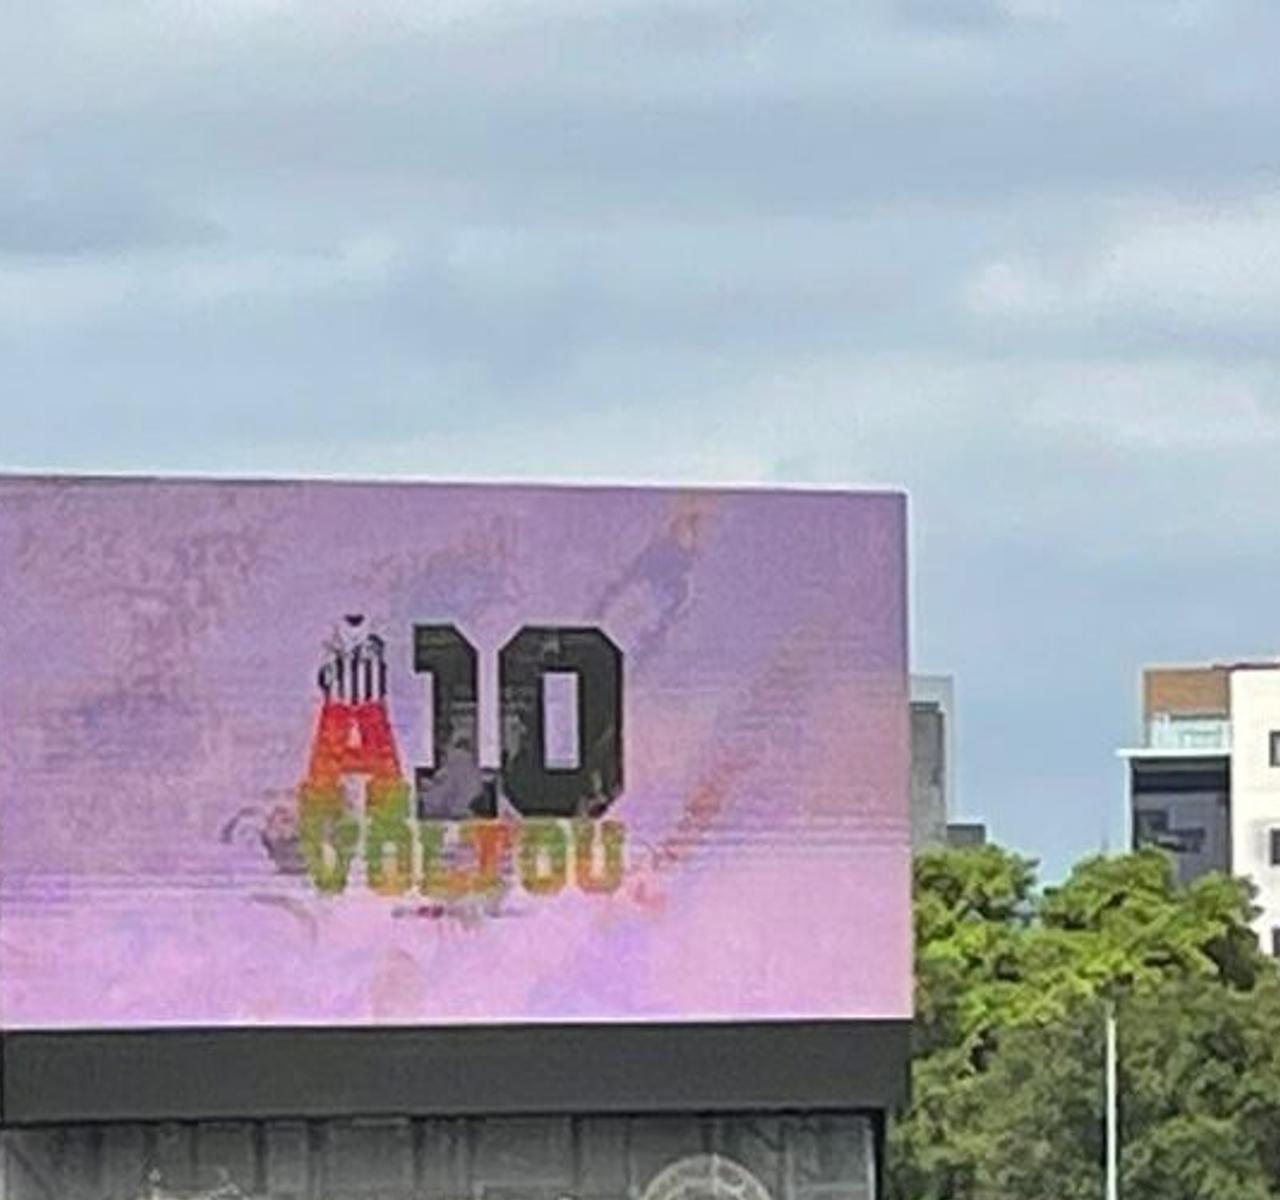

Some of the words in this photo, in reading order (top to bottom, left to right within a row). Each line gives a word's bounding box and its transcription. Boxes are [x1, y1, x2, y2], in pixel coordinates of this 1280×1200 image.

[300, 702, 413, 818] A
[413, 624, 625, 820] 10
[299, 820, 625, 897] VOLTOU
